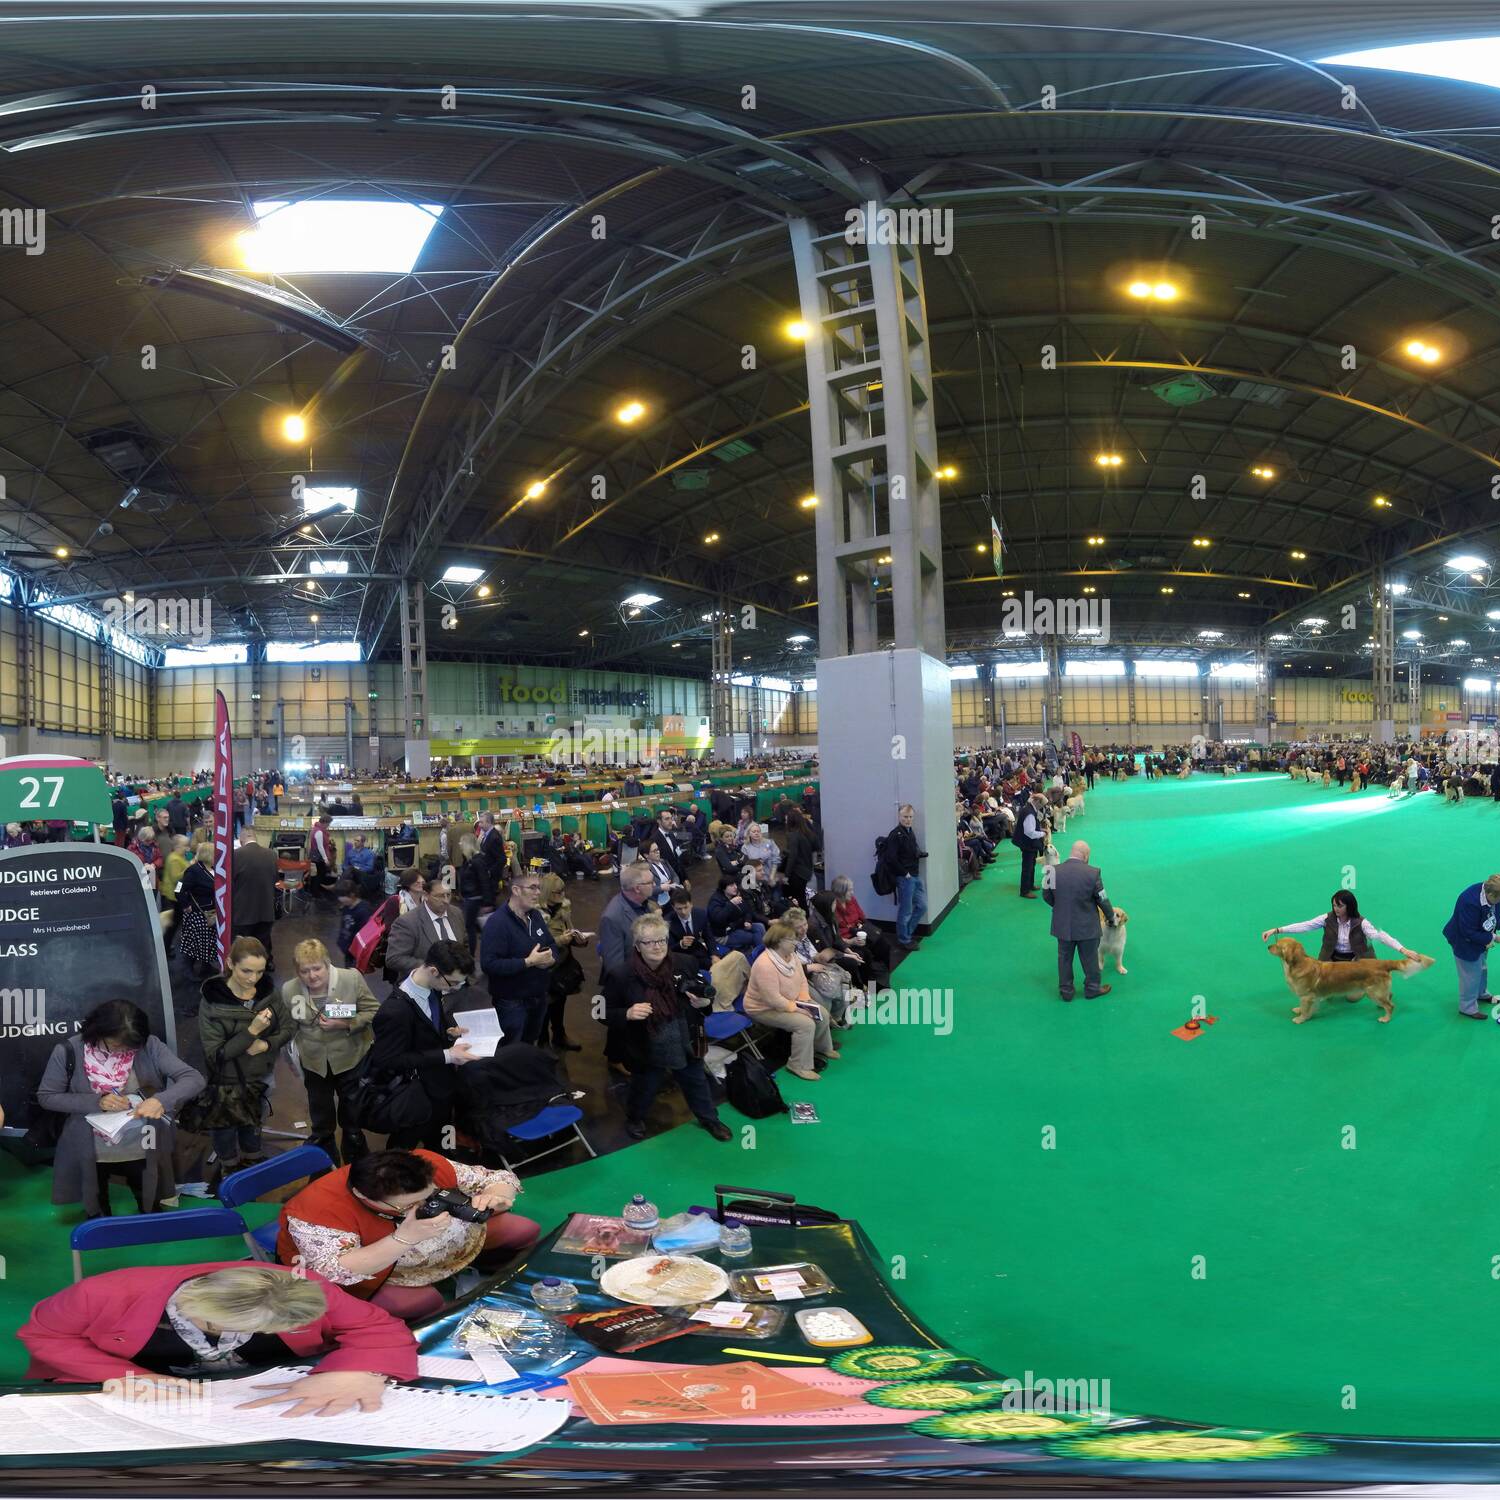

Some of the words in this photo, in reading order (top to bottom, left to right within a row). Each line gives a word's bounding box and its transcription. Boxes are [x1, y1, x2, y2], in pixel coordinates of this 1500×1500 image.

[498, 675, 568, 703] food
[19, 777, 65, 809] 27
[0, 869, 58, 884] DGING
[63, 866, 103, 880] NOW
[30, 888, 61, 897] Retriever
[61, 886, 91, 895] (Golden)
